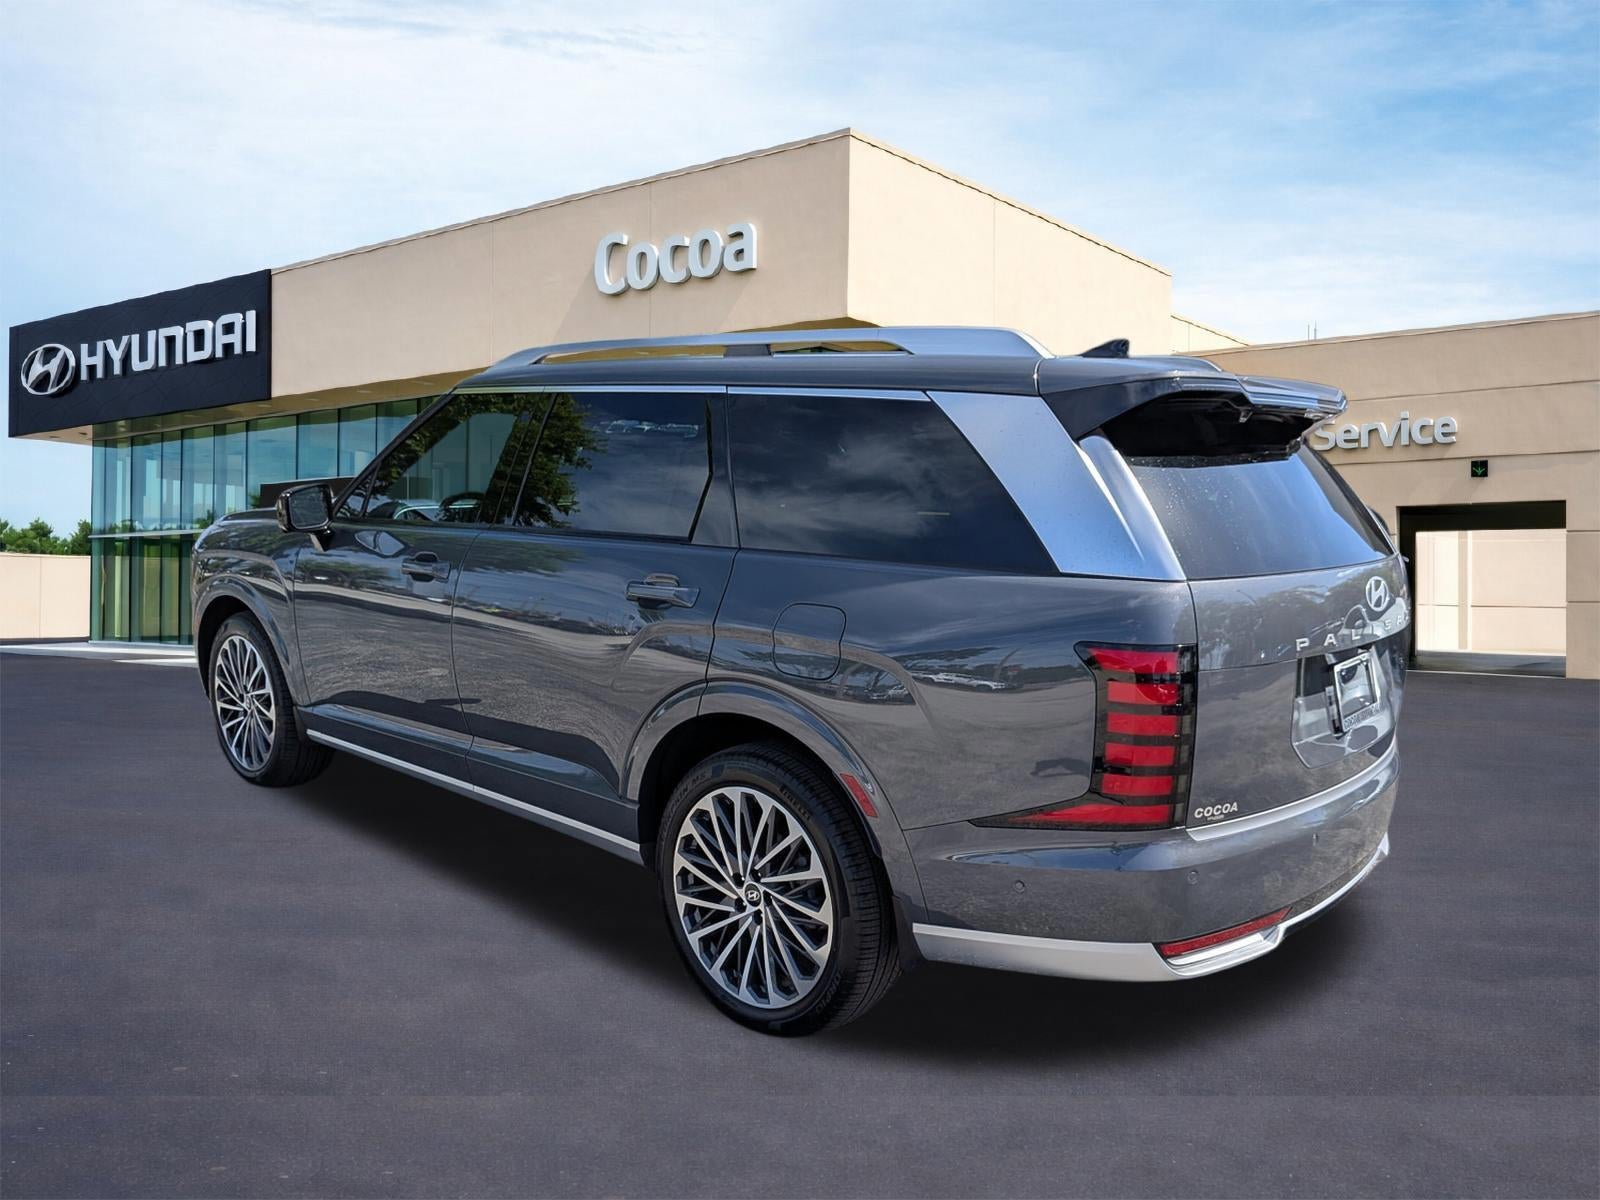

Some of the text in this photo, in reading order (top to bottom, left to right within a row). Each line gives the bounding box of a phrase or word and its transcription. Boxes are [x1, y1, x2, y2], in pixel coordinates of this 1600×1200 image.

[594, 222, 758, 296] Cocoa
[80, 310, 257, 381] HYUNDAI
[1312, 411, 1458, 451] Service
[1194, 801, 1239, 819] COCOA
